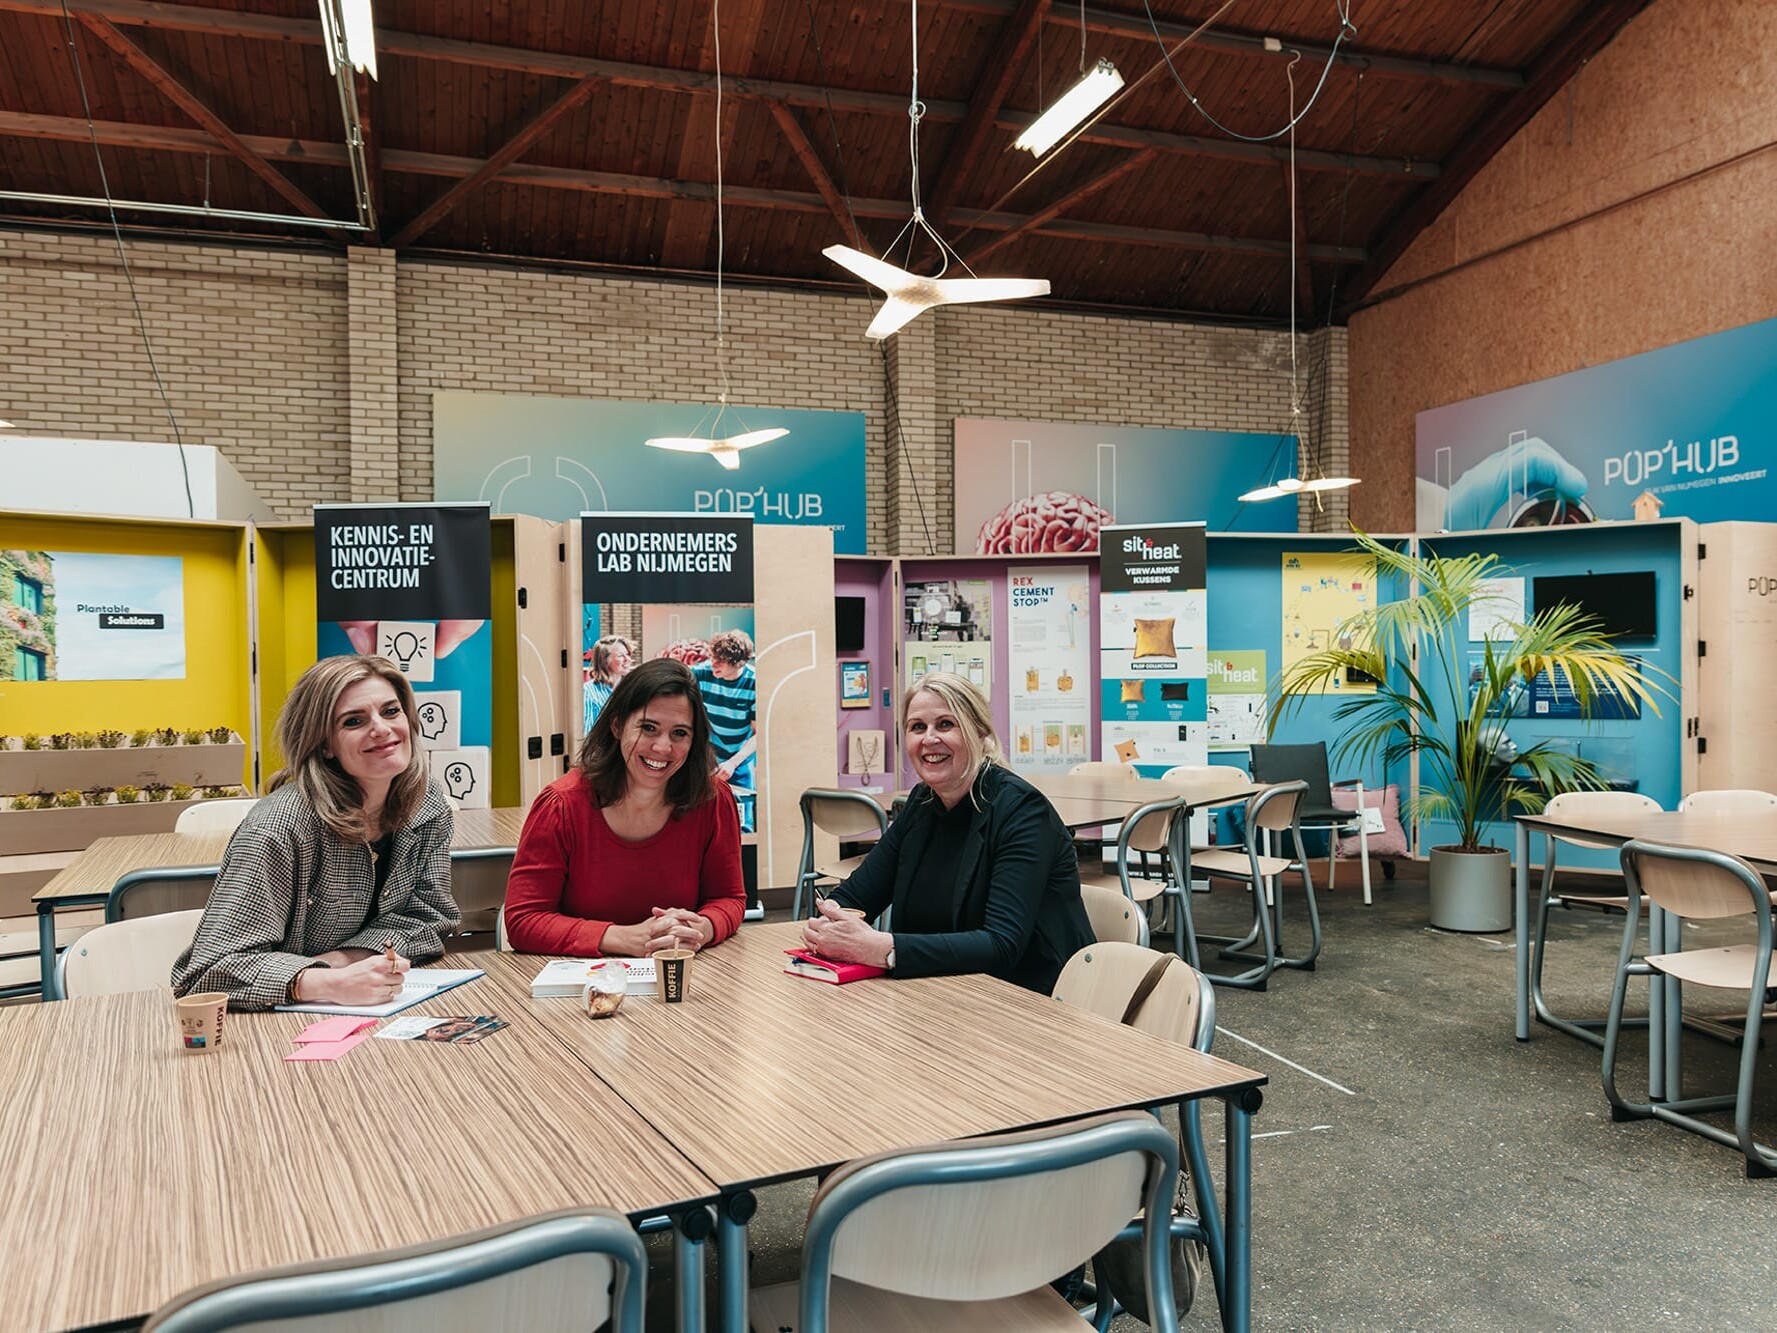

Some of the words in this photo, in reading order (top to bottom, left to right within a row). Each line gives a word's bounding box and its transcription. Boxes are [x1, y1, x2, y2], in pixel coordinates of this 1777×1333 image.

[330, 525, 405, 546] KENNIS-
[409, 524, 434, 545] EN
[596, 532, 738, 552] ONDERNEMERS
[331, 545, 435, 567] INNOVATIE-
[597, 553, 632, 572] LAB
[637, 553, 732, 572] NIJMEGEN
[330, 568, 420, 589] CENTRUM
[1124, 566, 1180, 576] VERWARMDE
[1132, 575, 1172, 585] KUSSENS
[1012, 576, 1034, 587] REX
[1012, 587, 1055, 597] CEMENT
[77, 604, 130, 613] Plantable
[107, 615, 155, 625] Solutions
[667, 963, 677, 998] KOFFIE
[214, 1006, 225, 1047] KOFFIE
